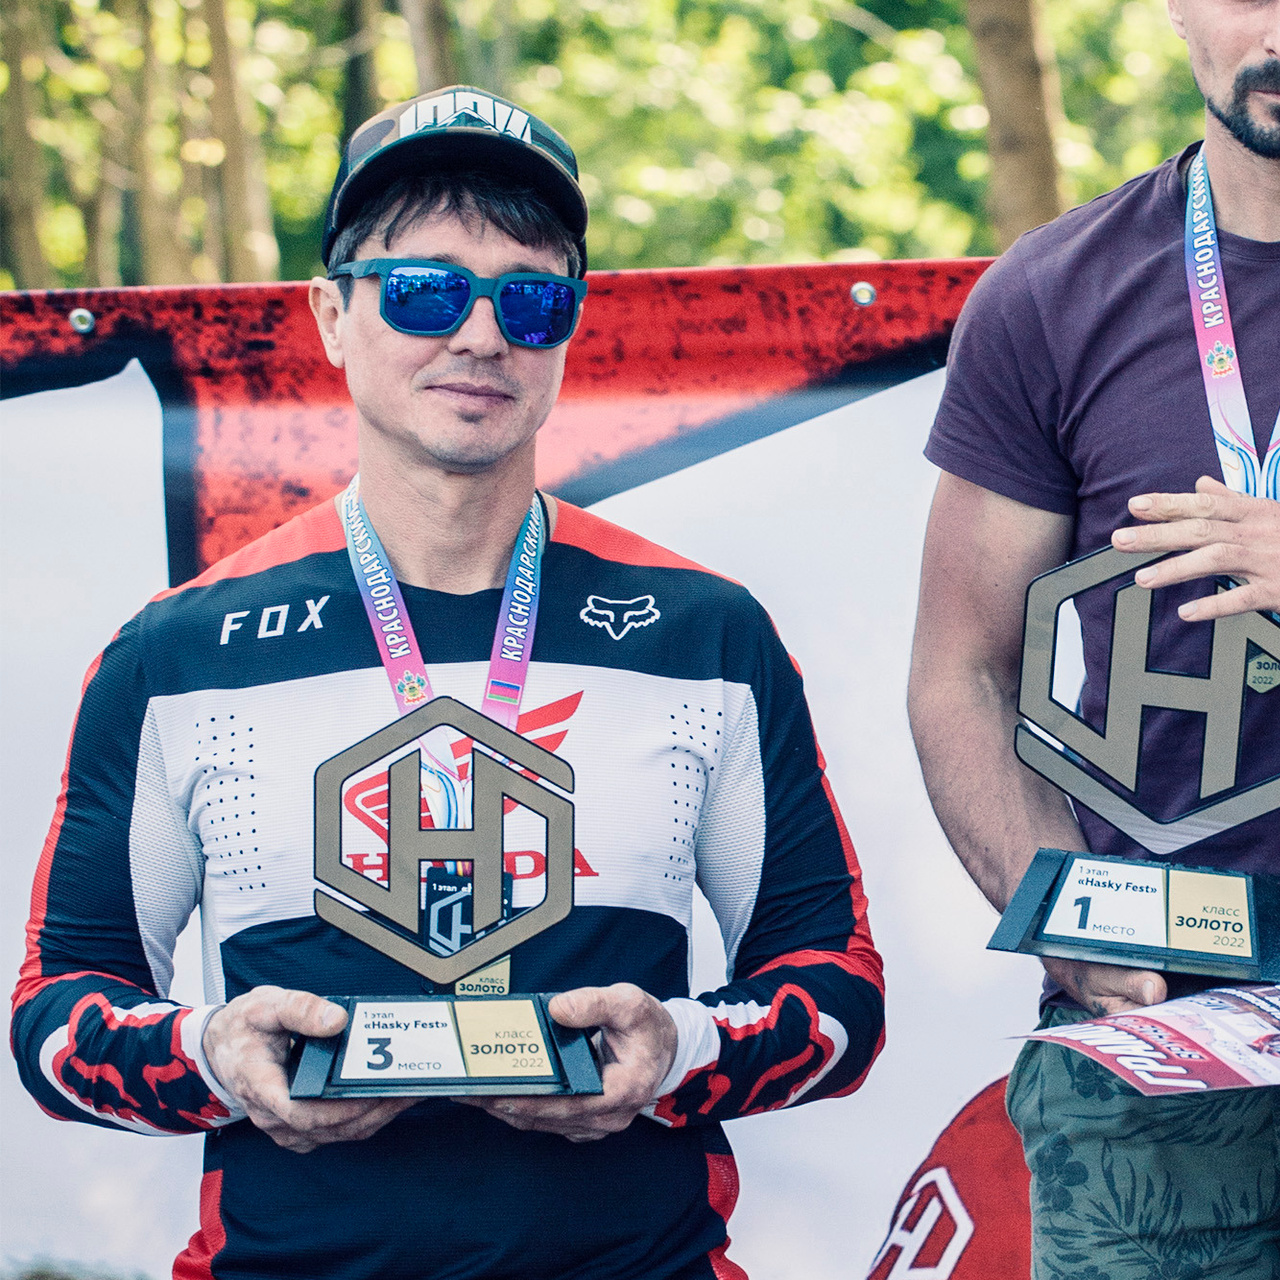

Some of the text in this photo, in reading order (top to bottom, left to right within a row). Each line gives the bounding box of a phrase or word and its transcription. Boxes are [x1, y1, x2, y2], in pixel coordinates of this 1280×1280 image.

[219, 595, 331, 645] FOX
[1252, 676, 1274, 684] 2022
[1086, 867, 1109, 877] этап
[1078, 877, 1158, 894] «Hasky Fest»
[1073, 896, 1136, 936] 1 место
[1202, 905, 1240, 917] класс
[1212, 935, 1245, 948] 2022
[364, 1021, 448, 1032] «Hasky Fest»
[495, 1030, 533, 1039] класс
[367, 1037, 442, 1070] 3 место
[512, 1058, 544, 1068] 2022
